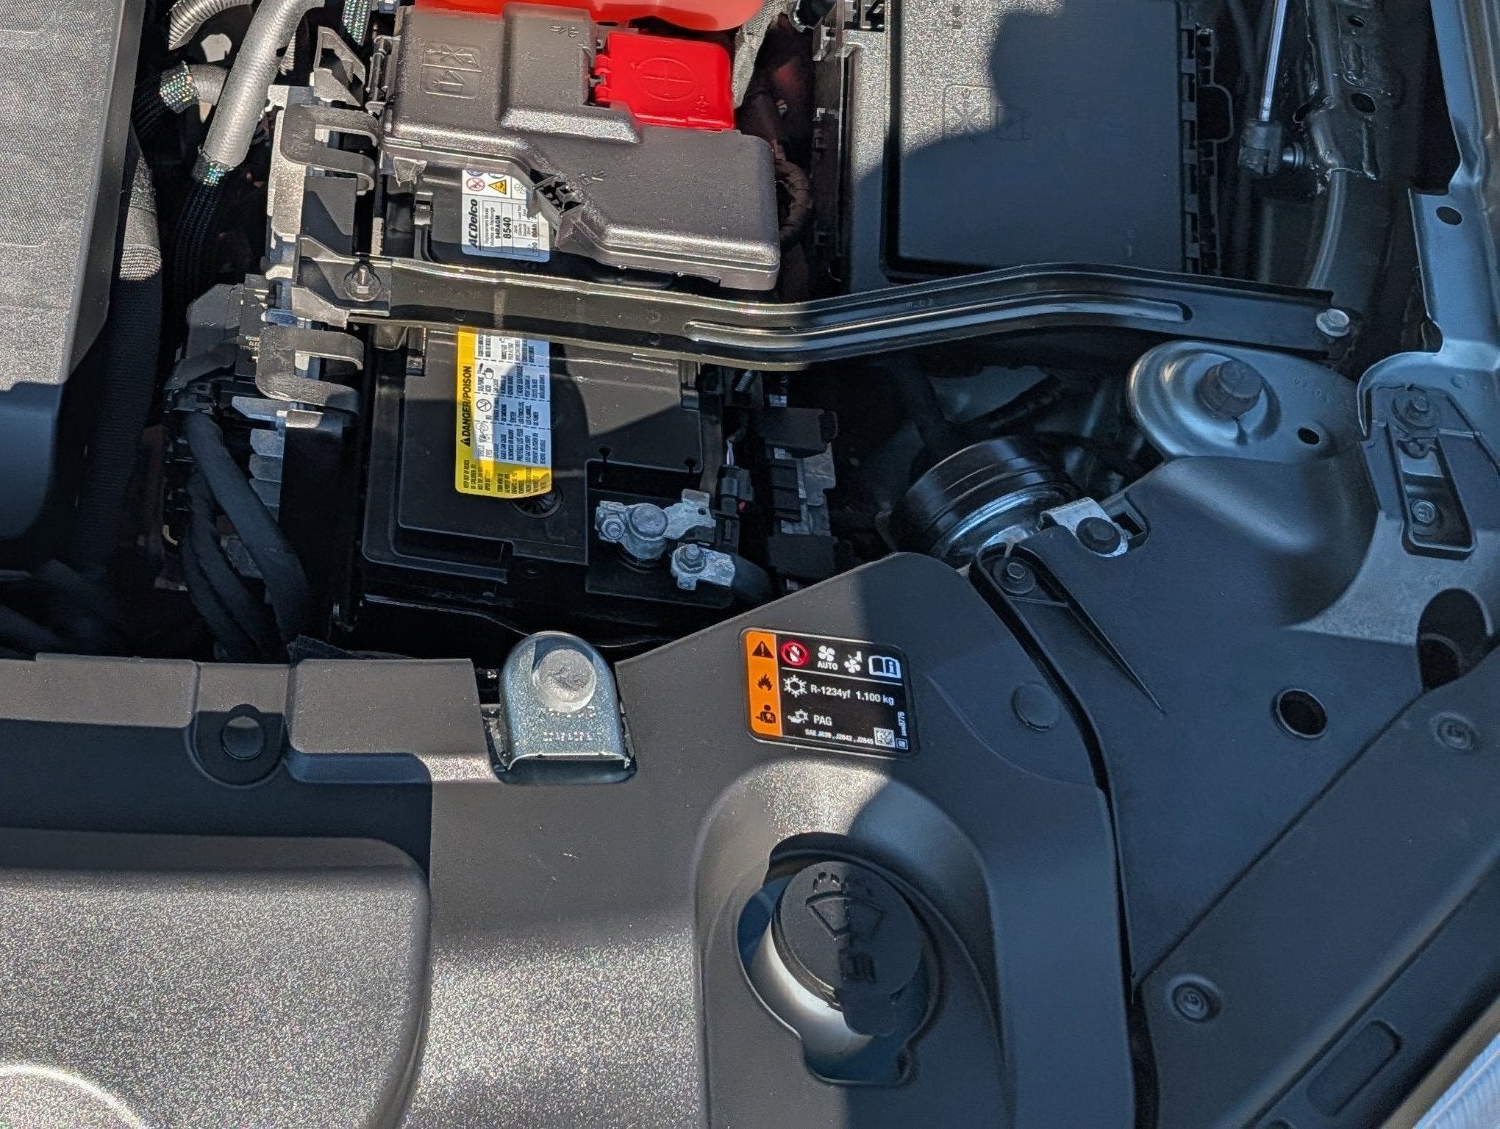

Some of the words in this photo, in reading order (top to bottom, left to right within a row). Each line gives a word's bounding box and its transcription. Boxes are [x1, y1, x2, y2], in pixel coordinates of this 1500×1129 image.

[467, 198, 479, 249] ACDelco
[503, 217, 512, 239] 8540
[461, 365, 472, 437] DANGER/POISON
[817, 661, 838, 671] AUTO
[810, 684, 851, 699] R-1234yf
[855, 691, 881, 703] 1.100
[883, 694, 895, 706] kg
[813, 714, 833, 727] PAG
